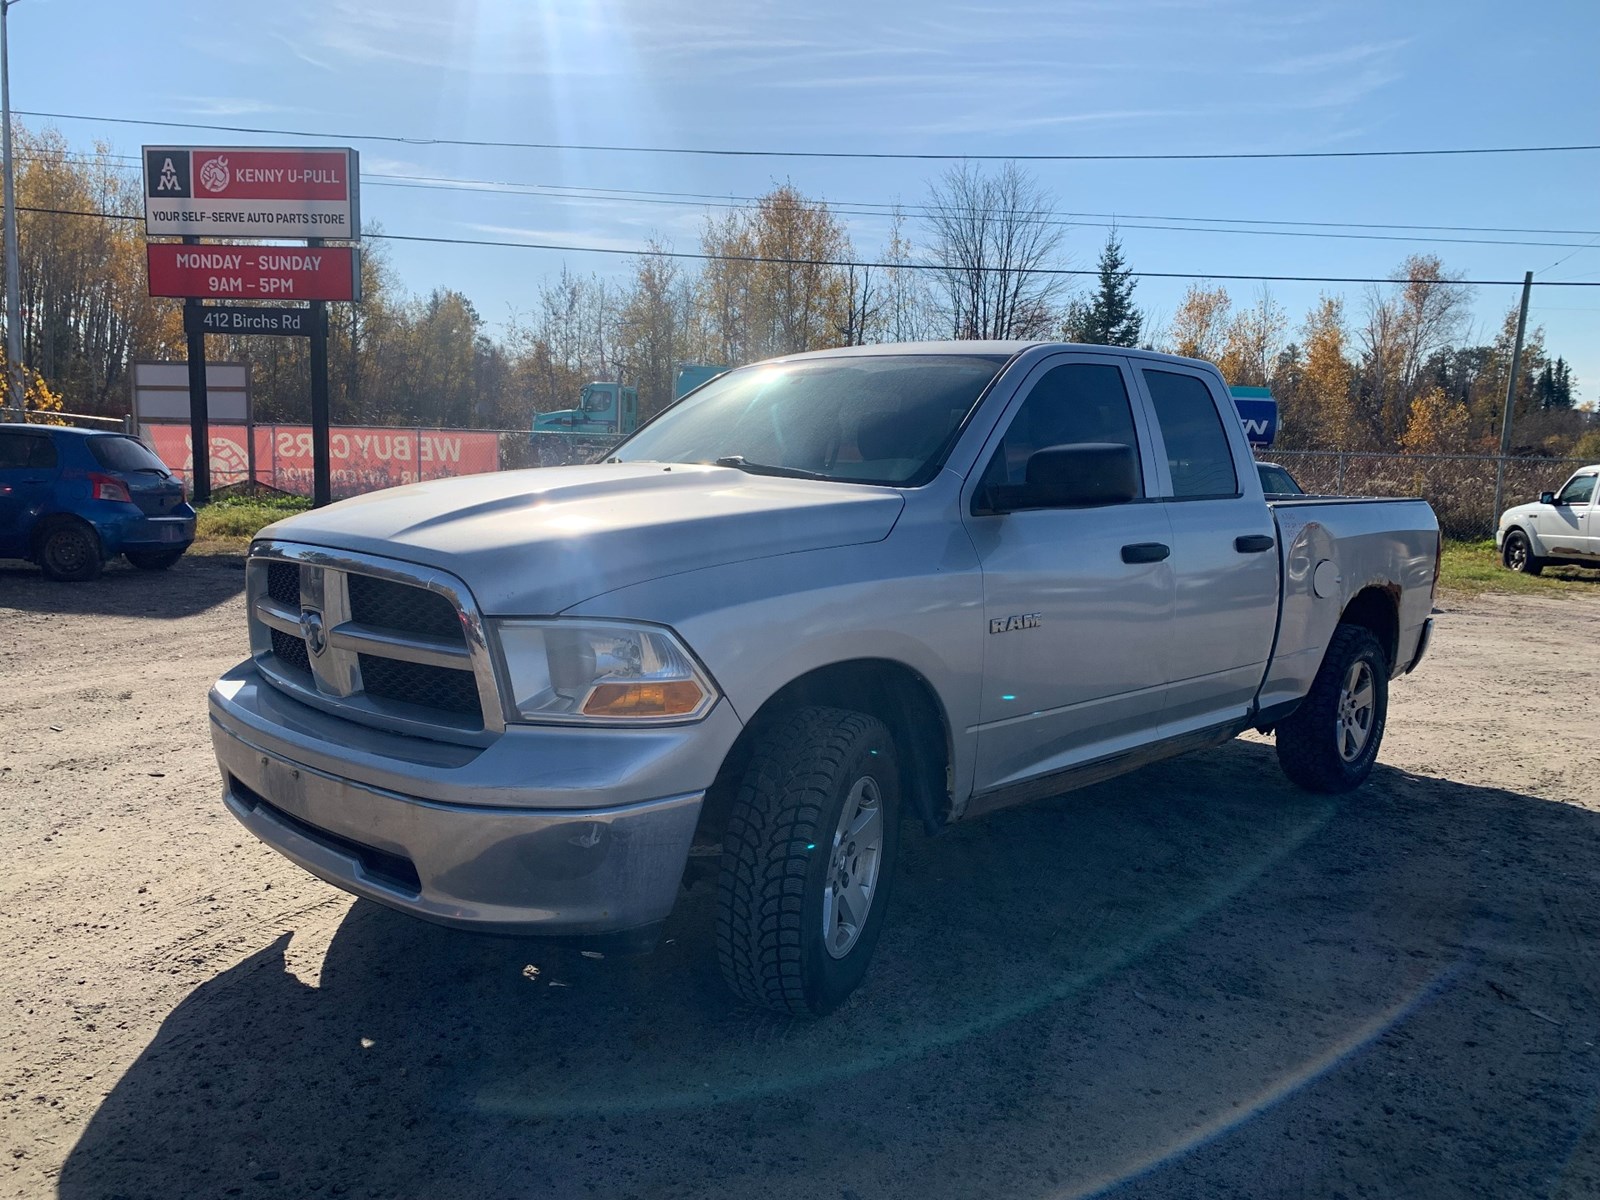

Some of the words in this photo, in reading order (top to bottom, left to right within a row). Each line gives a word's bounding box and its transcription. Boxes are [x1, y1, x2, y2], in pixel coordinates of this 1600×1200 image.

[236, 169, 283, 183] KENNY
[287, 169, 340, 184] U-PULL
[152, 211, 180, 222] YOUR
[181, 211, 245, 223] SELF-SERVE
[247, 212, 274, 223] AUTO
[276, 213, 309, 224] PARTS
[311, 213, 345, 224] STORE
[176, 254, 242, 270] MONDAY
[258, 256, 322, 271] SUNDAY
[208, 277, 243, 292] 9AM
[259, 278, 293, 293] 5PM
[203, 313, 229, 328] 412
[233, 314, 279, 329] Birchs
[282, 315, 300, 329] Rd
[989, 612, 1042, 635] RAM
